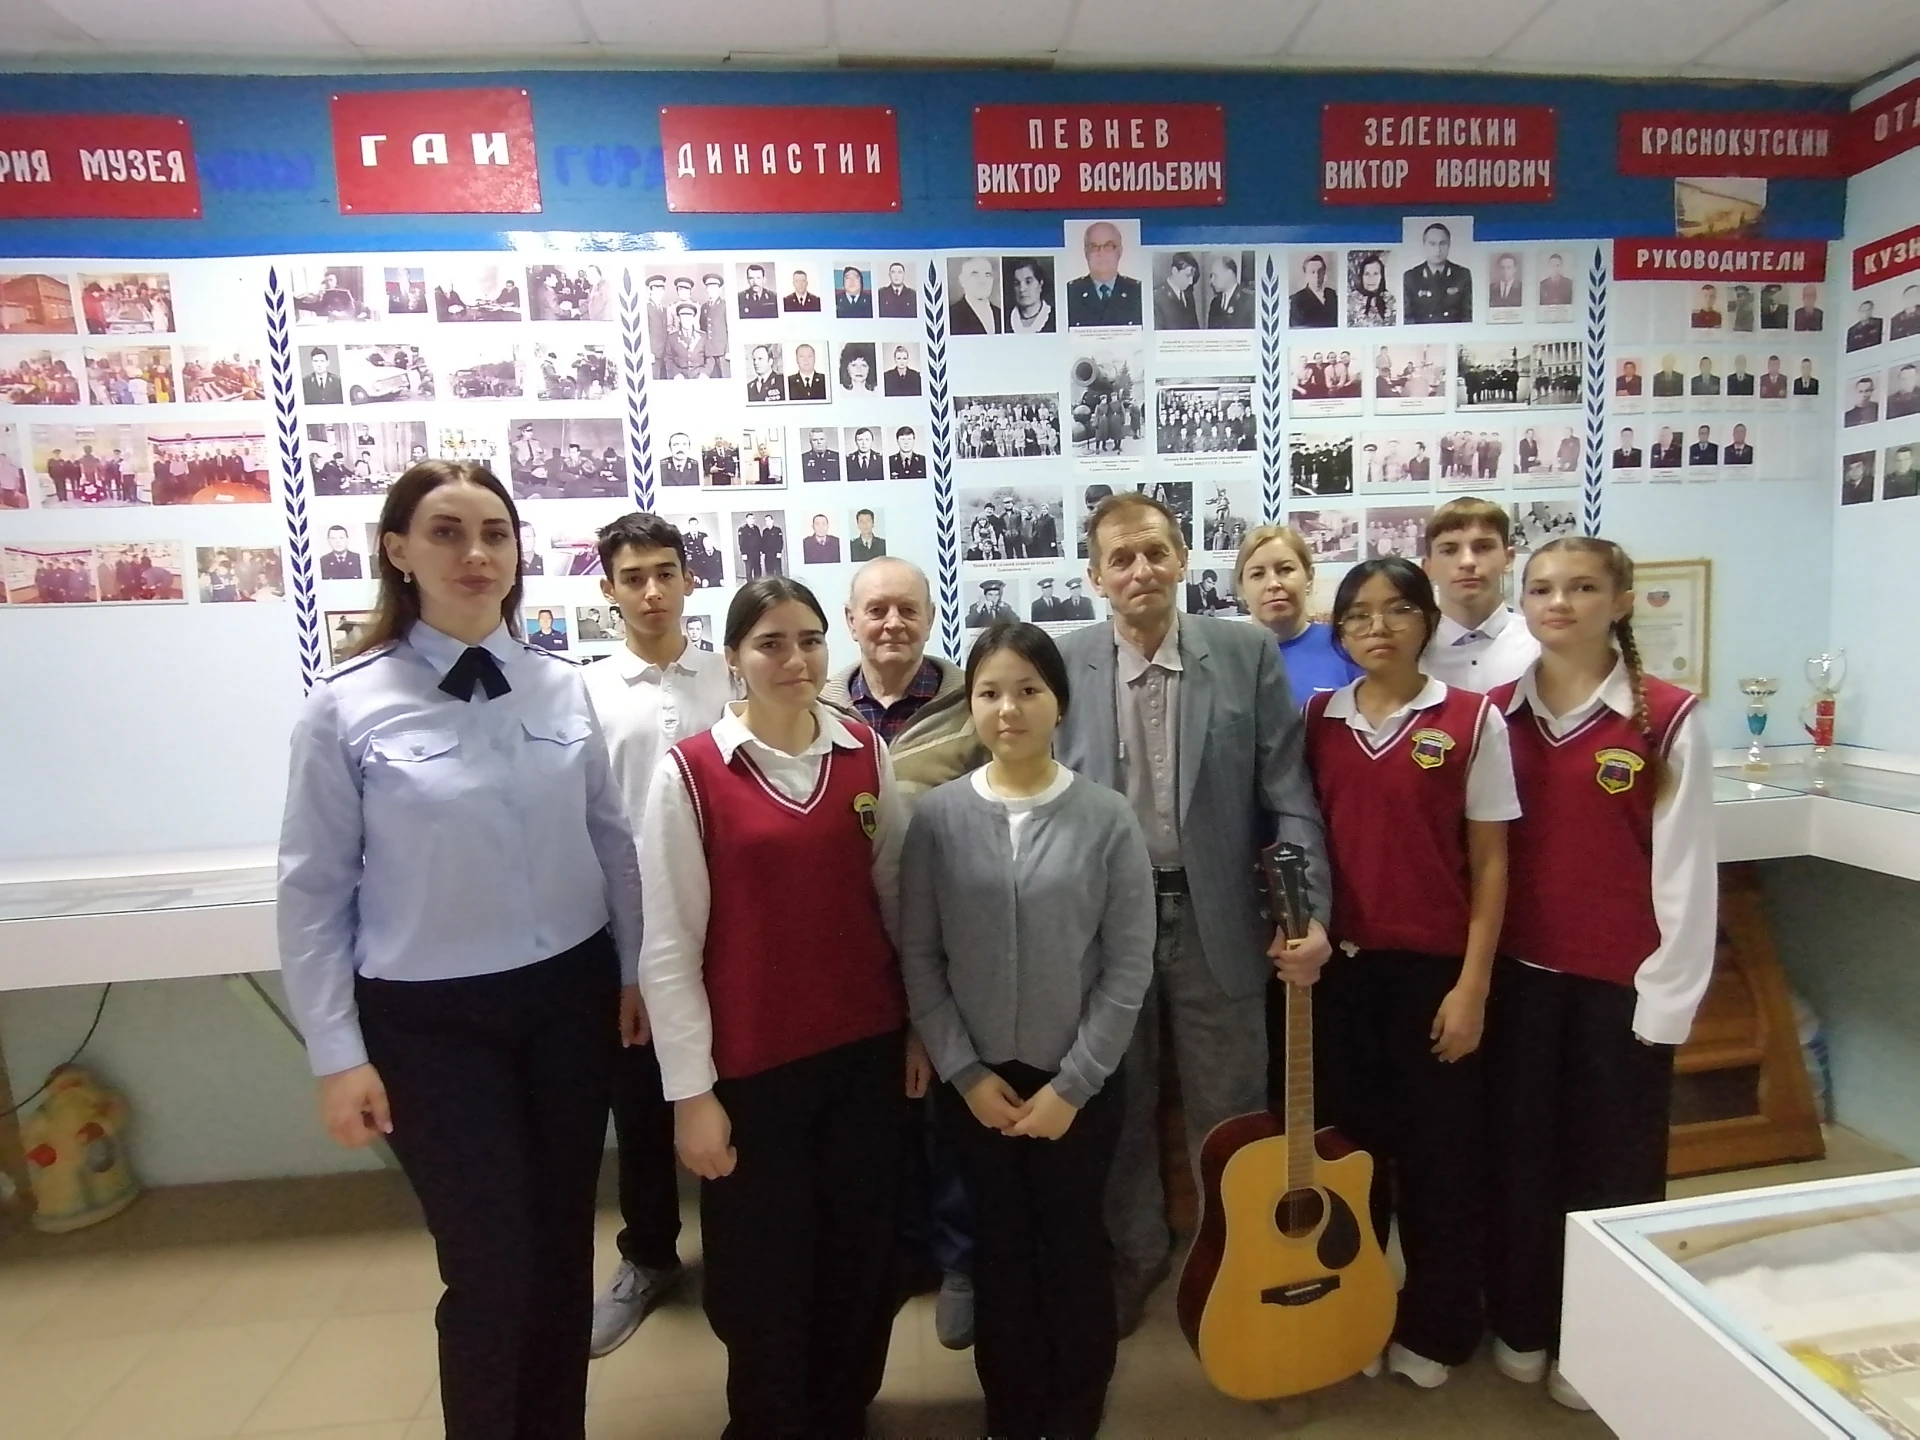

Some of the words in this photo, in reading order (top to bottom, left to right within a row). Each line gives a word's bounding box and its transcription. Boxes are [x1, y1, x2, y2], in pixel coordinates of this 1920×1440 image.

[360, 132, 510, 167] ГАИ
[1028, 118, 1169, 149] ПЕВНЕВ
[79, 149, 186, 183] МУЗЕЯ
[677, 142, 881, 178] ДИНАСТИИ
[1325, 159, 1409, 189] ВИКТОР
[1435, 158, 1550, 188] ИВАНОВИЧ
[977, 163, 1061, 193] ВИКТОР
[1079, 161, 1222, 192] ВАСИЛЬЕВИЧ
[1636, 248, 1806, 272] РУКОВОДИТЕЛИ
